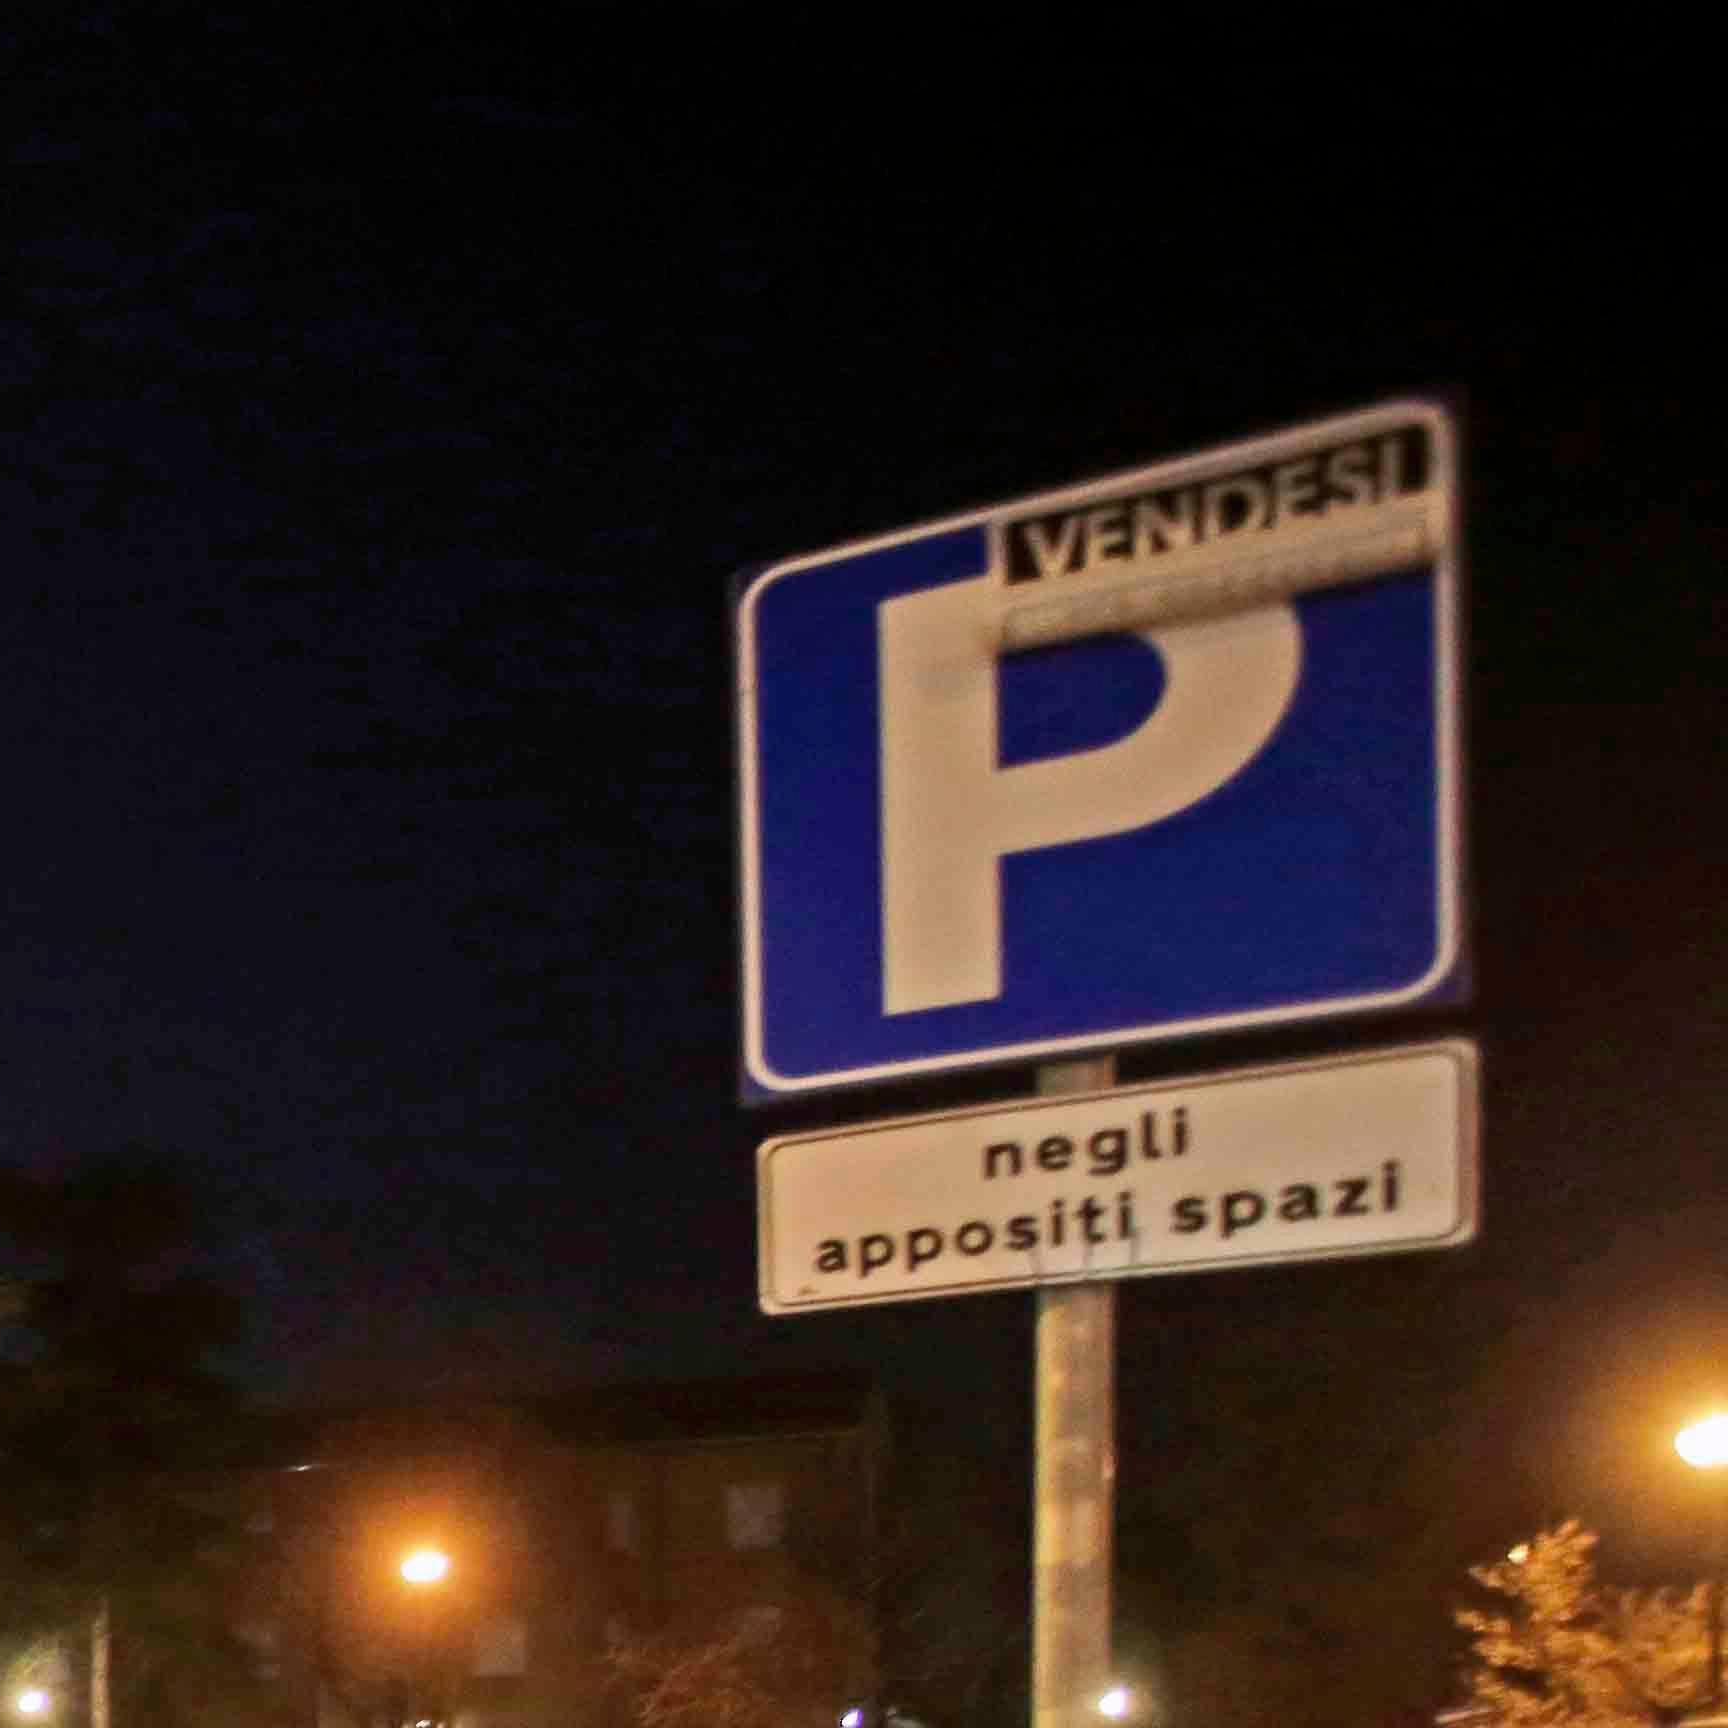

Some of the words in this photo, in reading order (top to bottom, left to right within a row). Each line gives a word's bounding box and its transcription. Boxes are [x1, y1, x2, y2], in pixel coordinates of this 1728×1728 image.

[1020, 430, 1406, 580] VENDESI
[877, 572, 1304, 1016] P
[982, 1106, 1192, 1180] negli
[815, 1190, 1138, 1279] appositi
[1170, 1159, 1402, 1238] spazi
